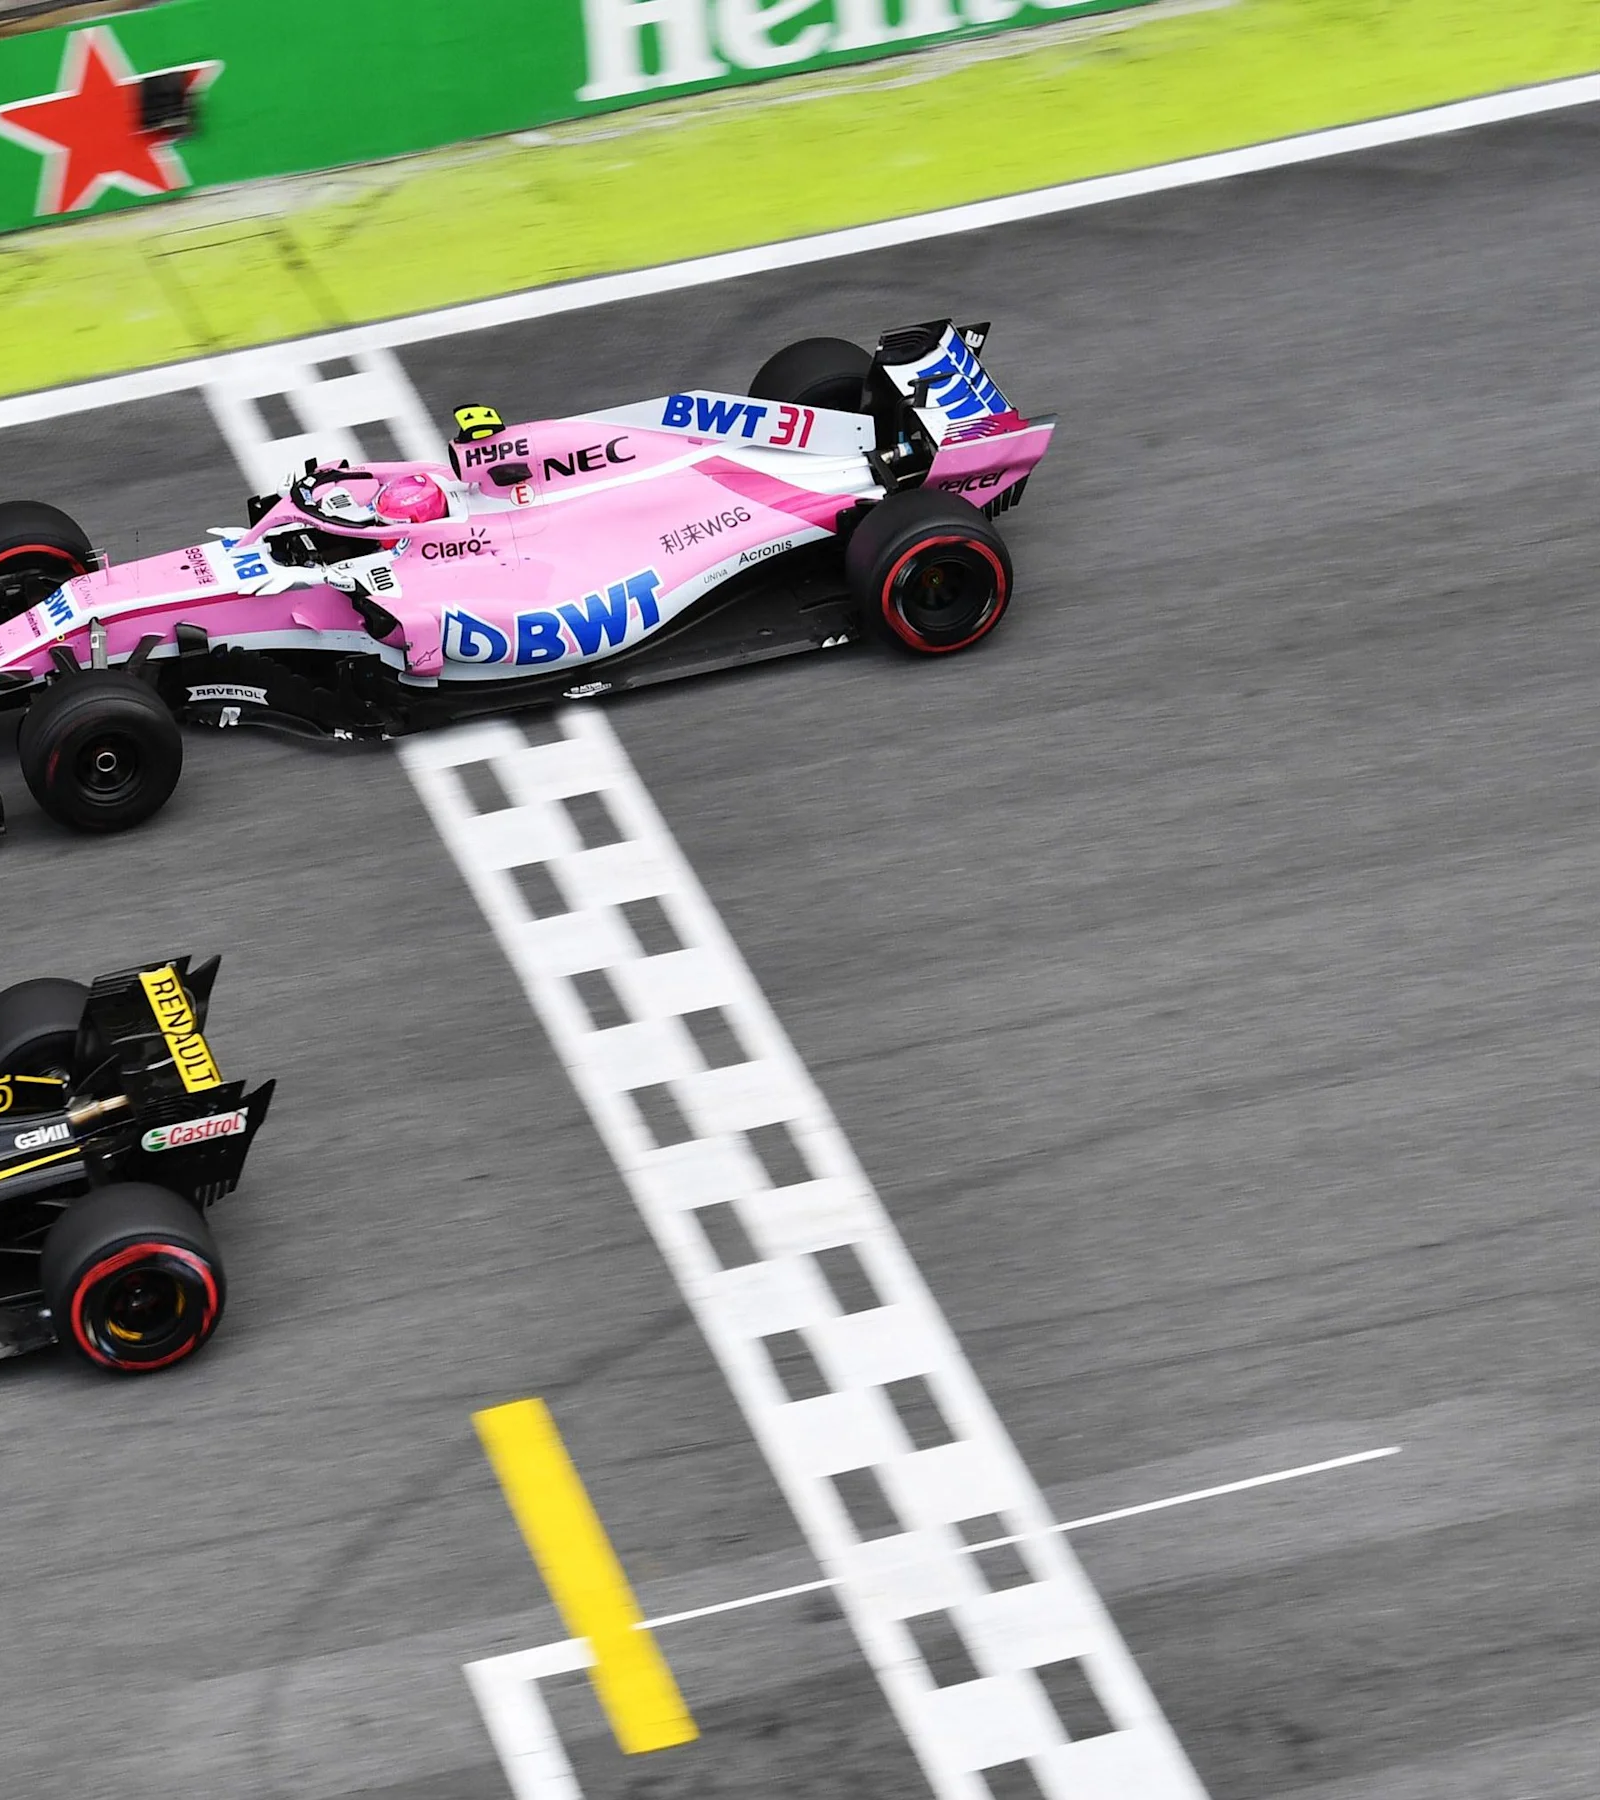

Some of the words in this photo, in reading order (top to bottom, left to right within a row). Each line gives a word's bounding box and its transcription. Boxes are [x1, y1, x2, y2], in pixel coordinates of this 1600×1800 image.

[662, 394, 767, 438] BWT
[769, 406, 815, 448] 31
[465, 438, 529, 467] HYPE
[543, 436, 636, 481] NEC
[515, 486, 529, 505] E
[659, 506, 751, 555] 利来W66
[421, 538, 481, 560] Claro
[738, 539, 793, 566] Acronis
[515, 567, 661, 665] BWT
[196, 686, 261, 699] RAVENOL
[150, 976, 216, 1085] RENAULT
[168, 1112, 241, 1146] Castrol
